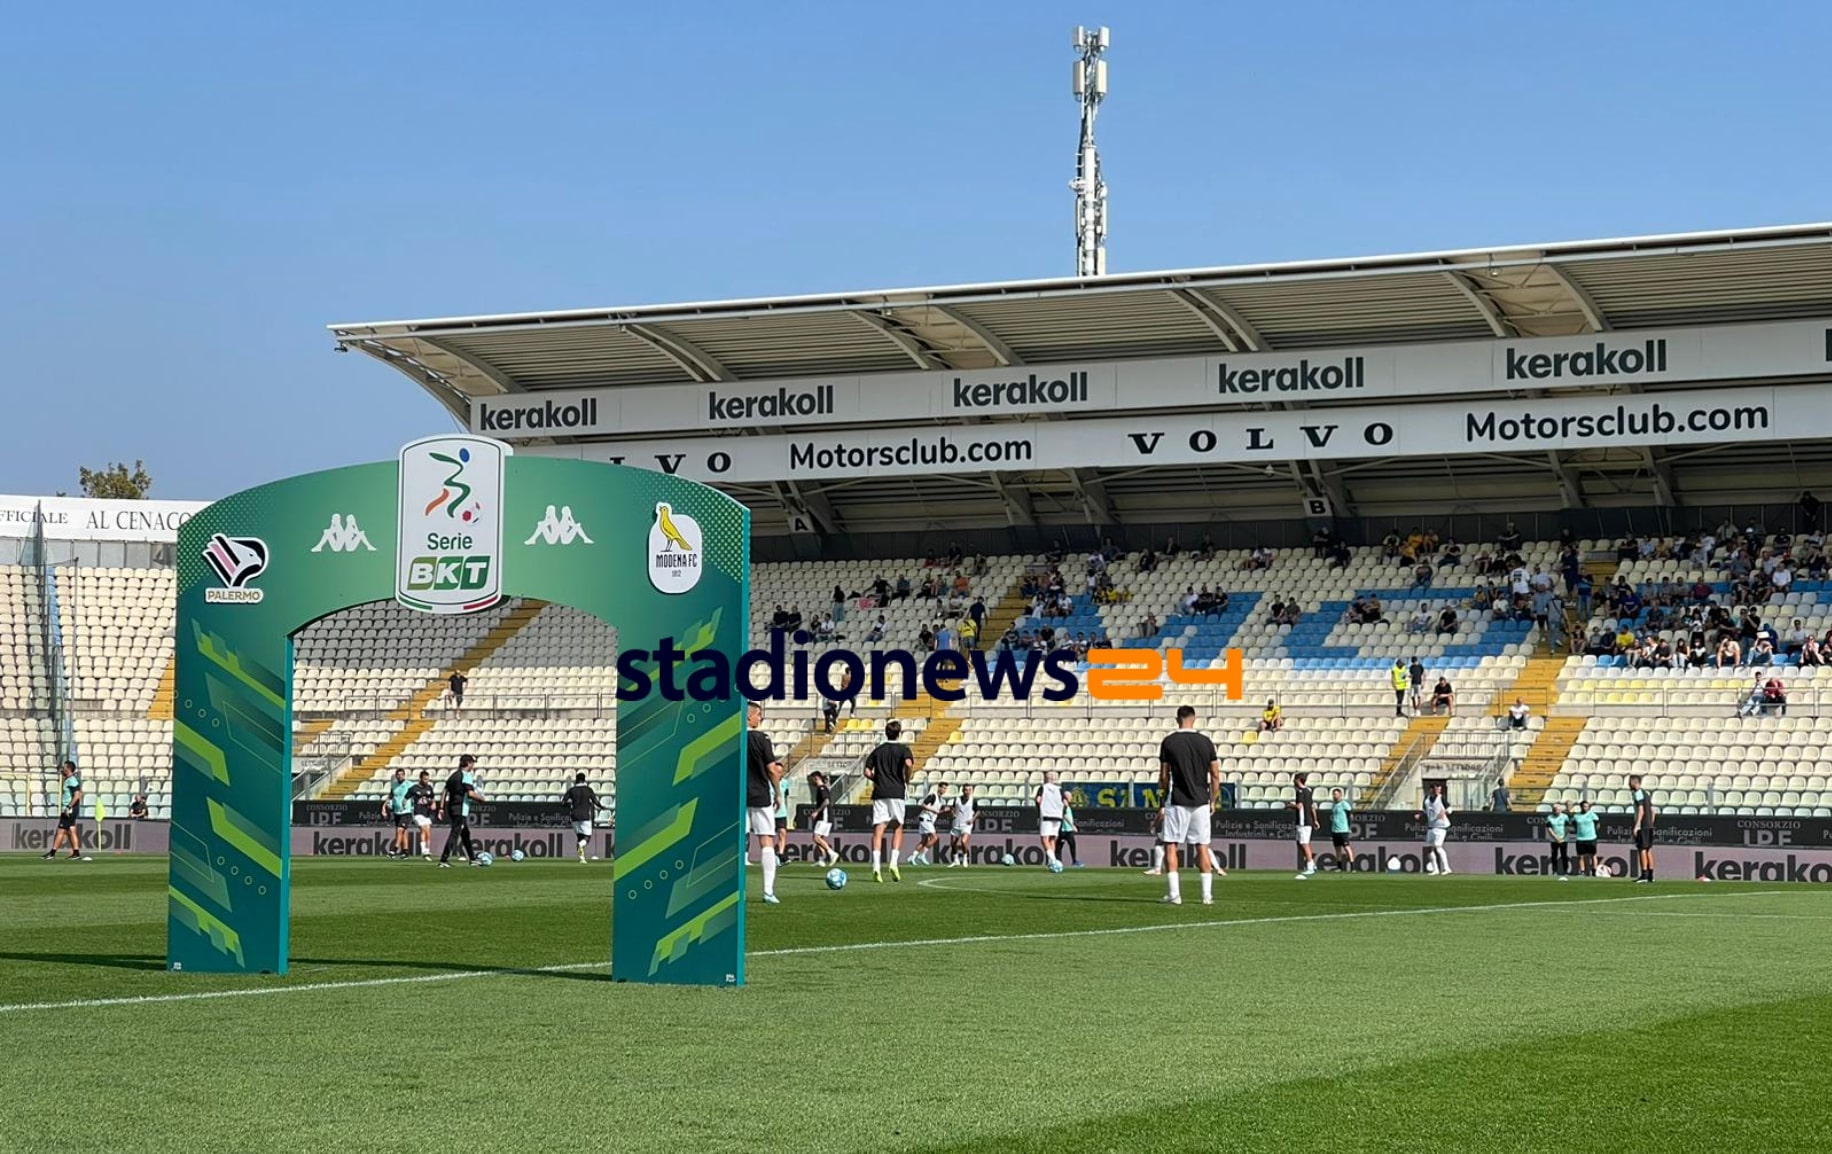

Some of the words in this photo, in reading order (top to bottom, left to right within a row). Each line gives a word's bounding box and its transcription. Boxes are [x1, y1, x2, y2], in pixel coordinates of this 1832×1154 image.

[1507, 339, 1667, 380] kerakoll
[954, 372, 1088, 407] kerakoll
[1218, 357, 1364, 394] kerakoll
[480, 398, 598, 431] kerakoll
[709, 385, 834, 420] kerakoll
[1466, 404, 1768, 442] Motorsclub.com
[790, 436, 1032, 470] Motorsclub.com
[1128, 422, 1394, 455] VOLVO
[85, 510, 110, 530] AL
[1309, 500, 1326, 515] B
[795, 517, 809, 531] A
[427, 533, 472, 551] Serie
[408, 560, 489, 587] BKT
[656, 554, 687, 568] MODENA
[689, 553, 698, 568] FC
[207, 591, 260, 601] PALERMO
[1737, 819, 1801, 829] CONSORZIO
